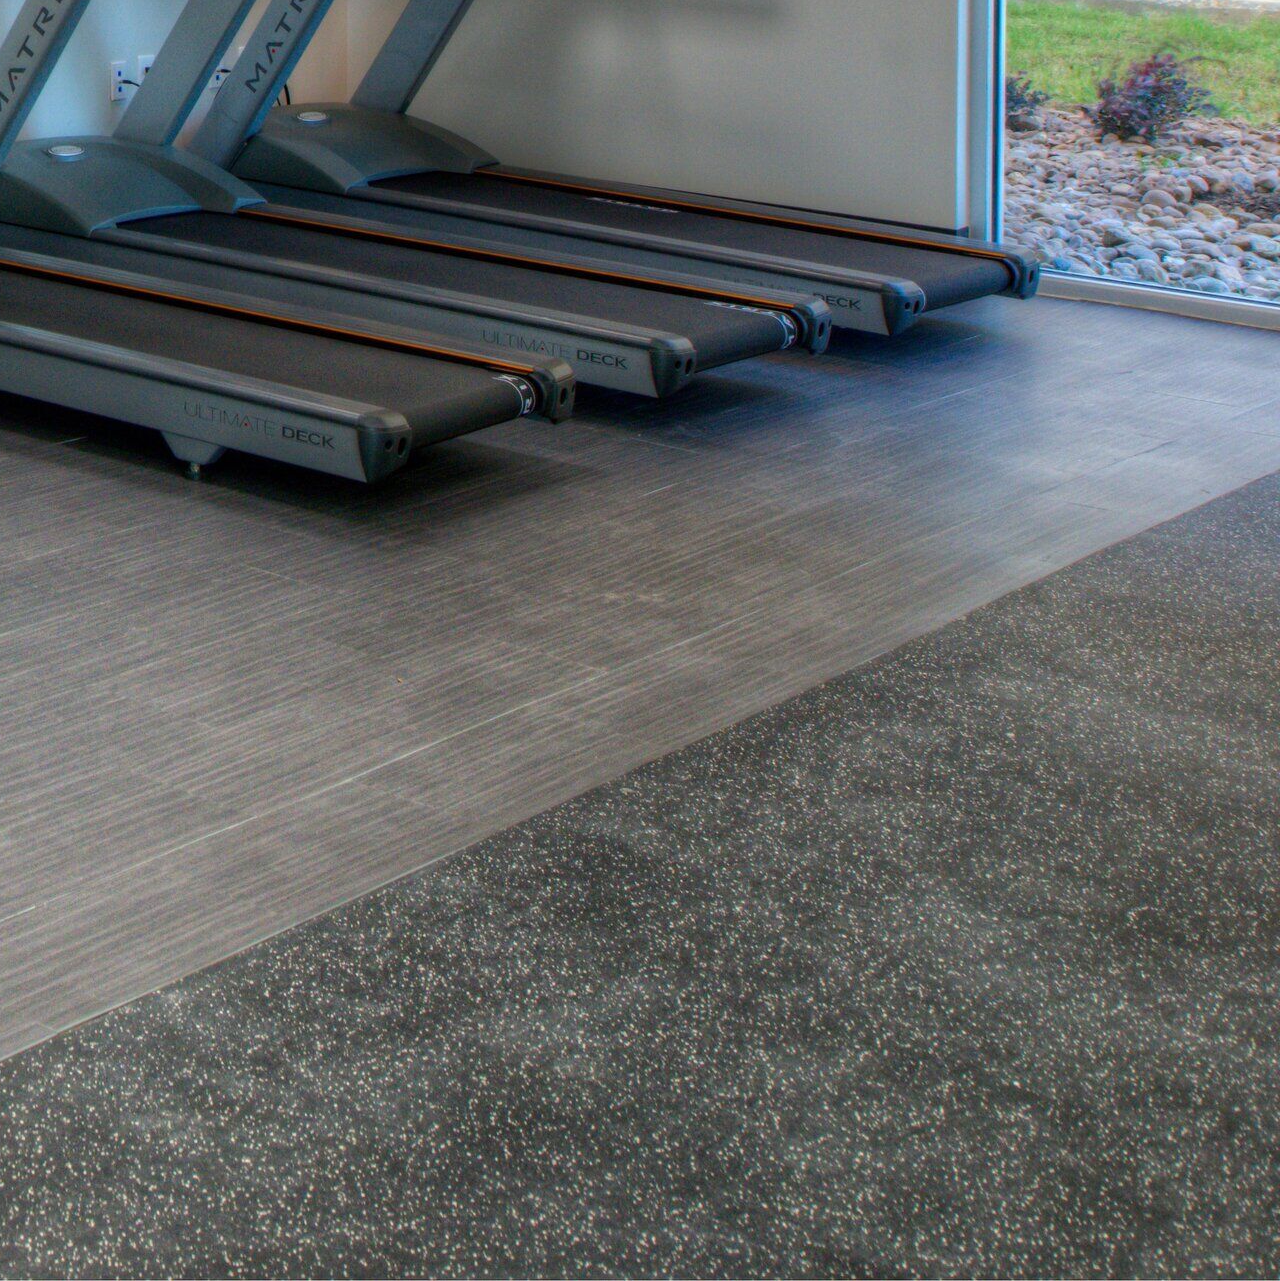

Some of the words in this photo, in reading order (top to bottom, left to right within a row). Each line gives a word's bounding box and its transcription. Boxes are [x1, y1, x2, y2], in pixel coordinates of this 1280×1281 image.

[482, 329, 573, 360] ULTIMATE
[577, 349, 627, 369] DECK
[184, 401, 275, 436] ULTIMATE
[282, 426, 335, 449] DECK
